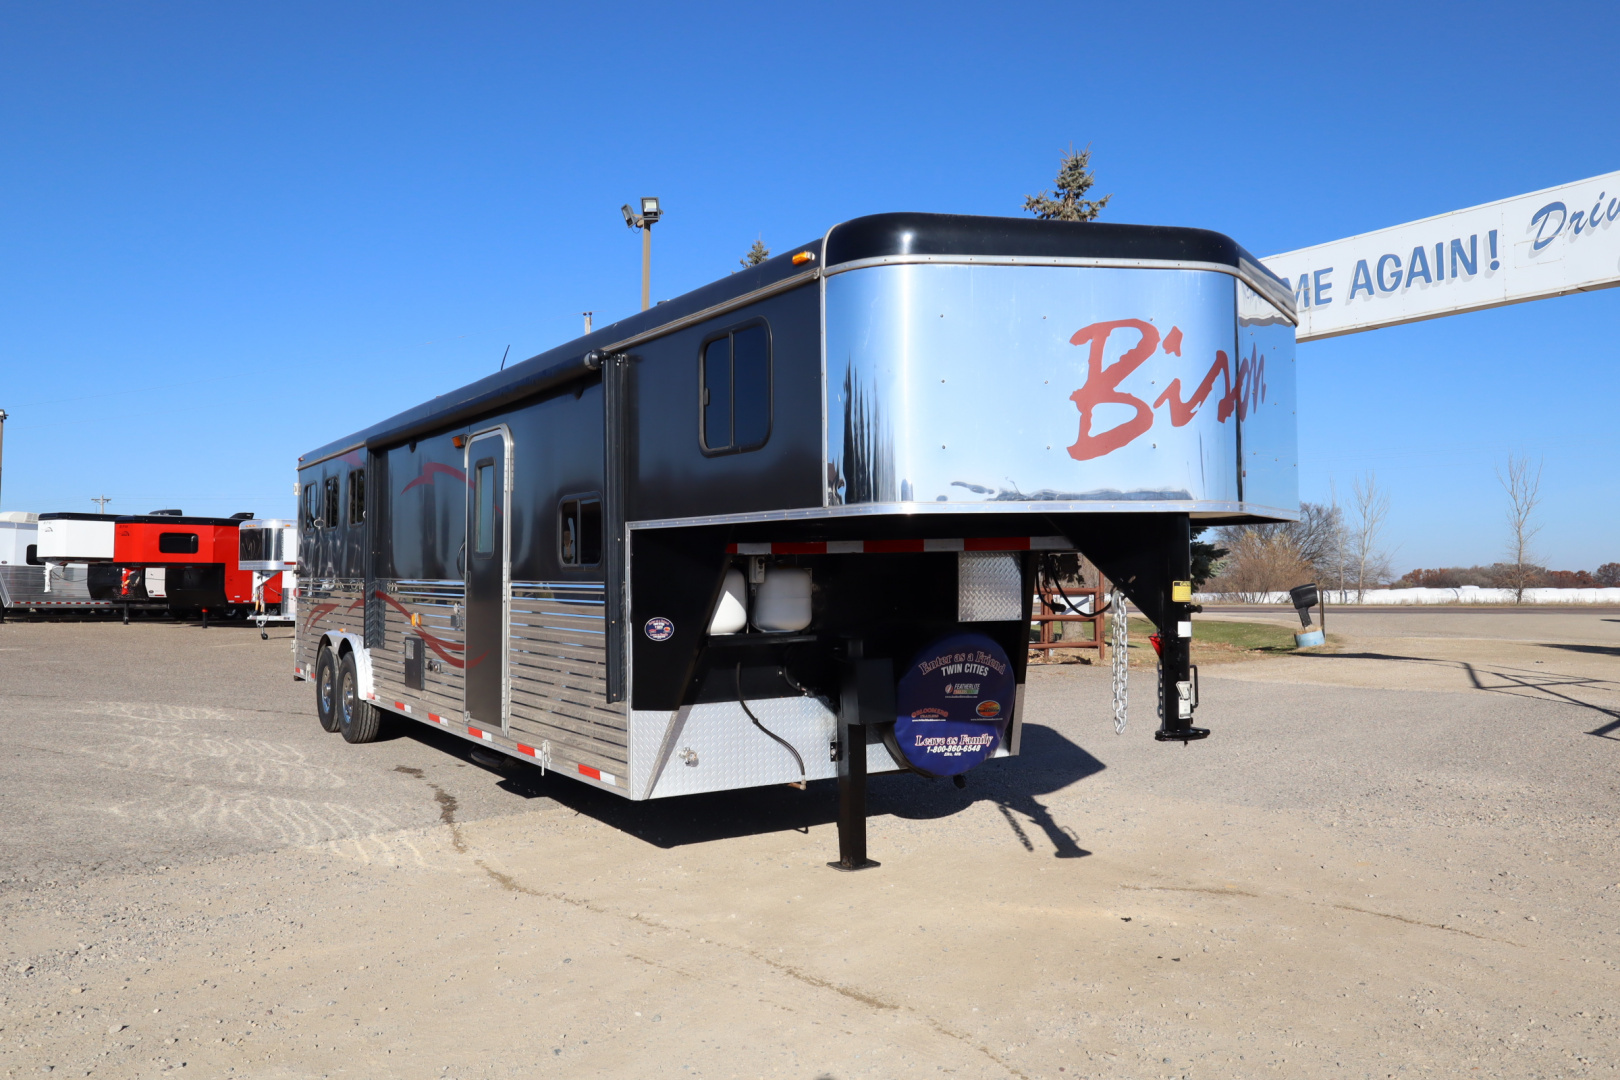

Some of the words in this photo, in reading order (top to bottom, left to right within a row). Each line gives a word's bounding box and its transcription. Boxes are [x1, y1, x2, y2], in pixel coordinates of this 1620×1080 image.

[1349, 229, 1500, 300] AGAIN!
[918, 654, 953, 675] Enter
[953, 651, 967, 662] as
[968, 651, 974, 662] a
[975, 651, 1006, 675] Friend
[941, 664, 963, 677] TWIN
[964, 663, 990, 677] CITIES
[915, 735, 946, 746] Leave
[946, 736, 958, 745] as
[959, 733, 994, 747] Family
